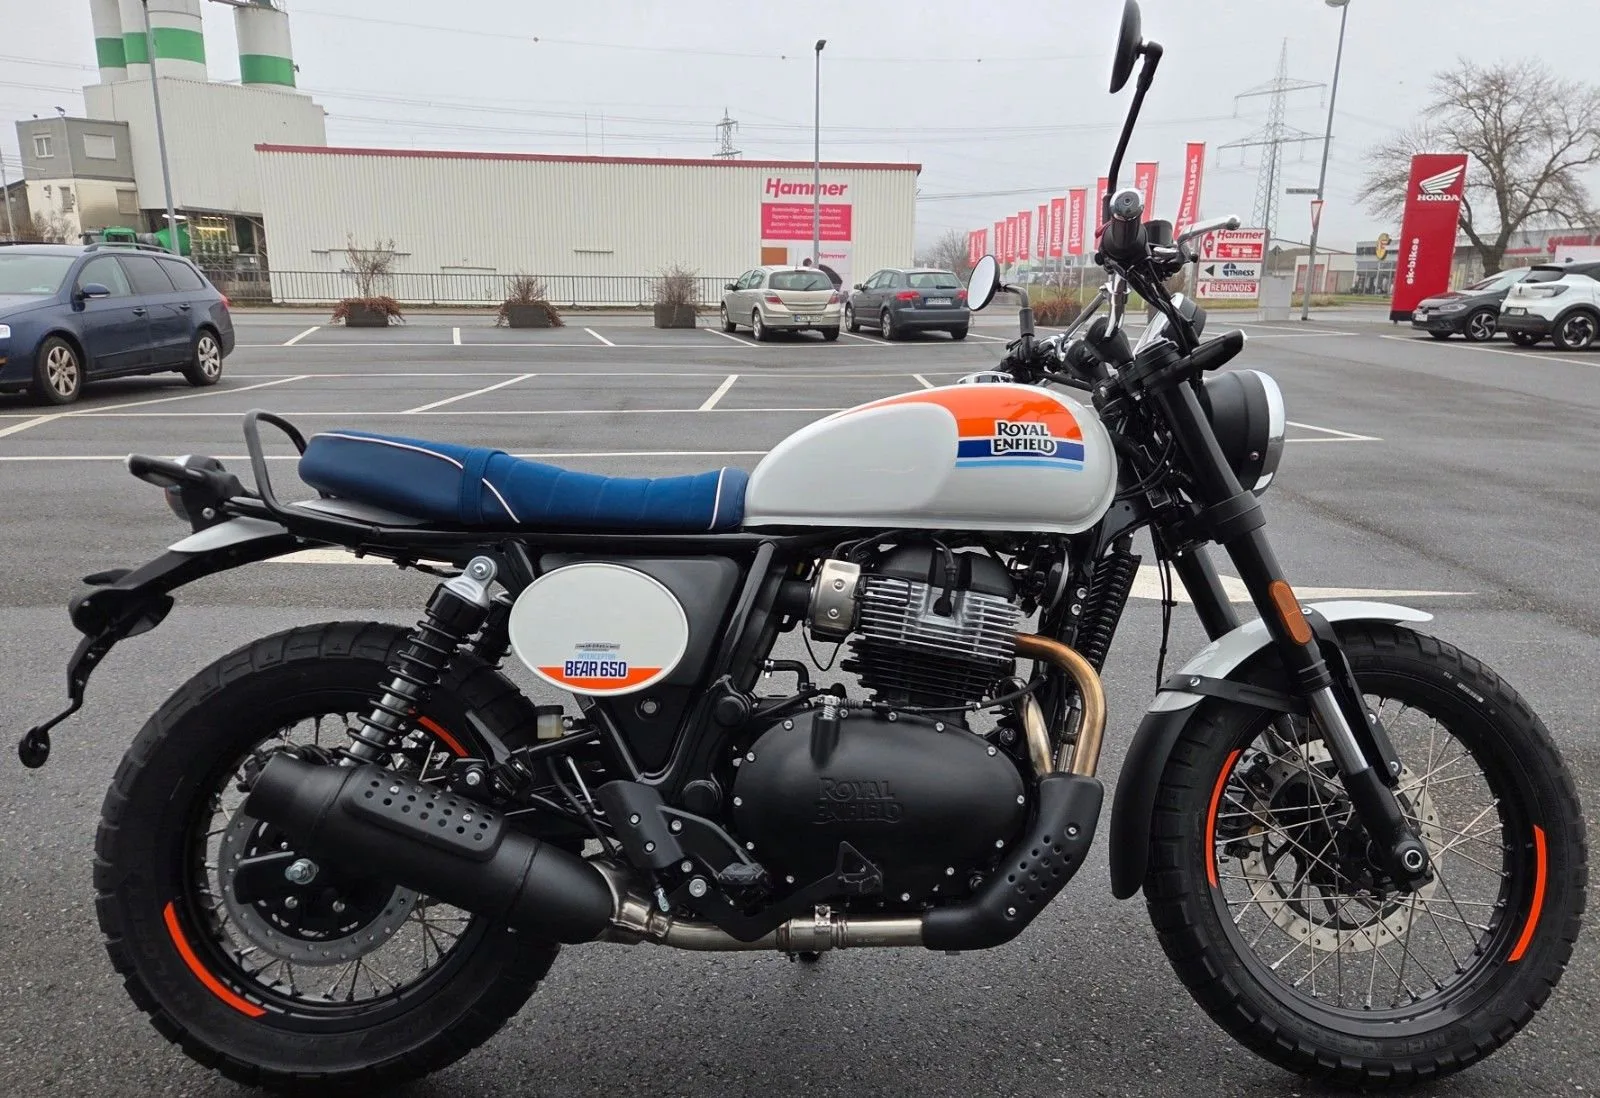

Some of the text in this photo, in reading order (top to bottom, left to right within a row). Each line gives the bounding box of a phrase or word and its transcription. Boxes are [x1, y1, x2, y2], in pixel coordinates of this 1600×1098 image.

[765, 178, 848, 198] Hammer
[1217, 229, 1264, 241] Hammer
[1406, 238, 1420, 285] sk-bikes
[1211, 283, 1252, 292] REMONDIS
[997, 422, 1049, 437] ROYAL
[993, 438, 1055, 454] ENFIELD
[565, 661, 627, 677] BEAR 650
[819, 777, 895, 802] ROYAL
